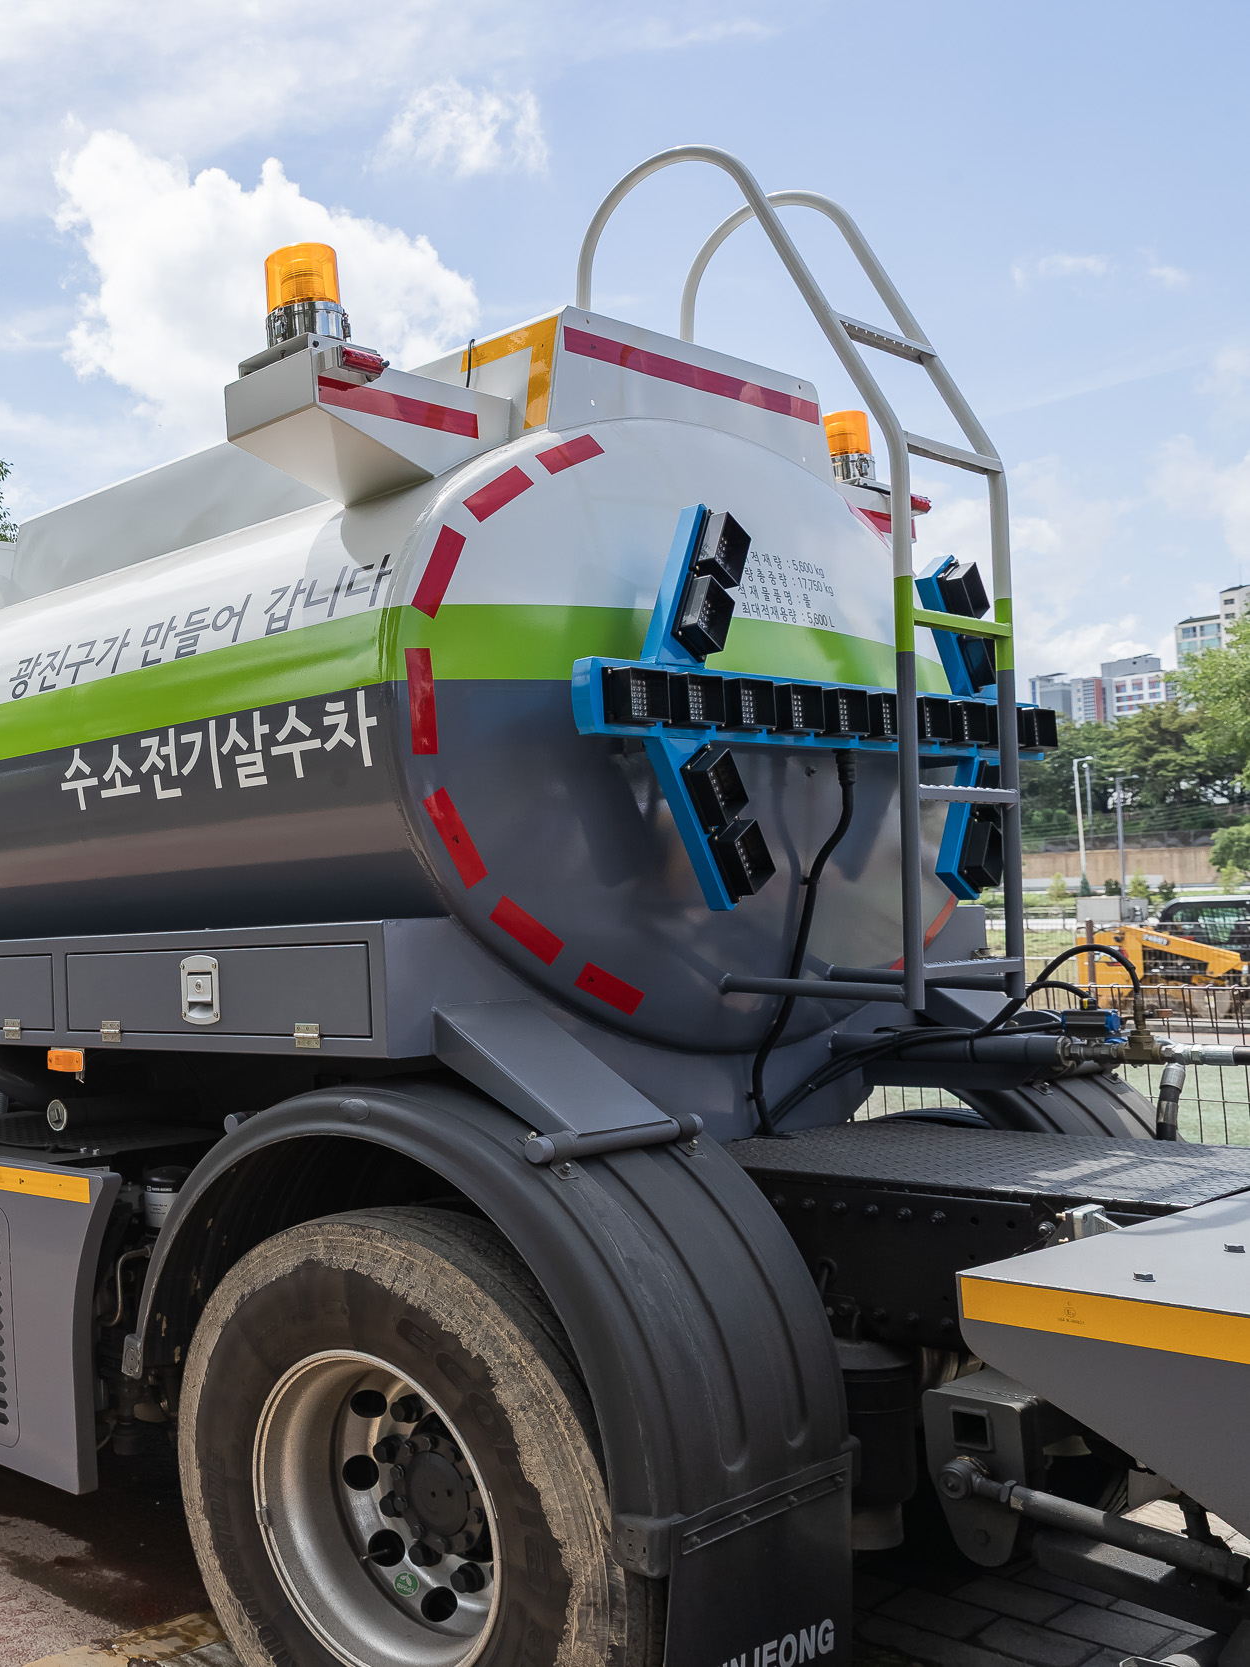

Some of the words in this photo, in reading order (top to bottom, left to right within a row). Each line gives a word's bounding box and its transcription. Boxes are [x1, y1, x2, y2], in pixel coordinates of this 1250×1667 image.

[746, 551, 783, 570] 적재량
[791, 559, 815, 576] 5,600
[814, 564, 825, 579] kg
[743, 567, 788, 588] 량총중량
[797, 577, 822, 593] 17,750
[822, 581, 835, 597] kg
[802, 593, 812, 609] 물
[9, 627, 131, 699] 광진구가
[139, 594, 253, 669] 만들어
[263, 552, 393, 637] 갑니다
[806, 611, 828, 627] 5,600
[829, 615, 836, 628] L
[59, 689, 379, 812] 수소전기살수차
